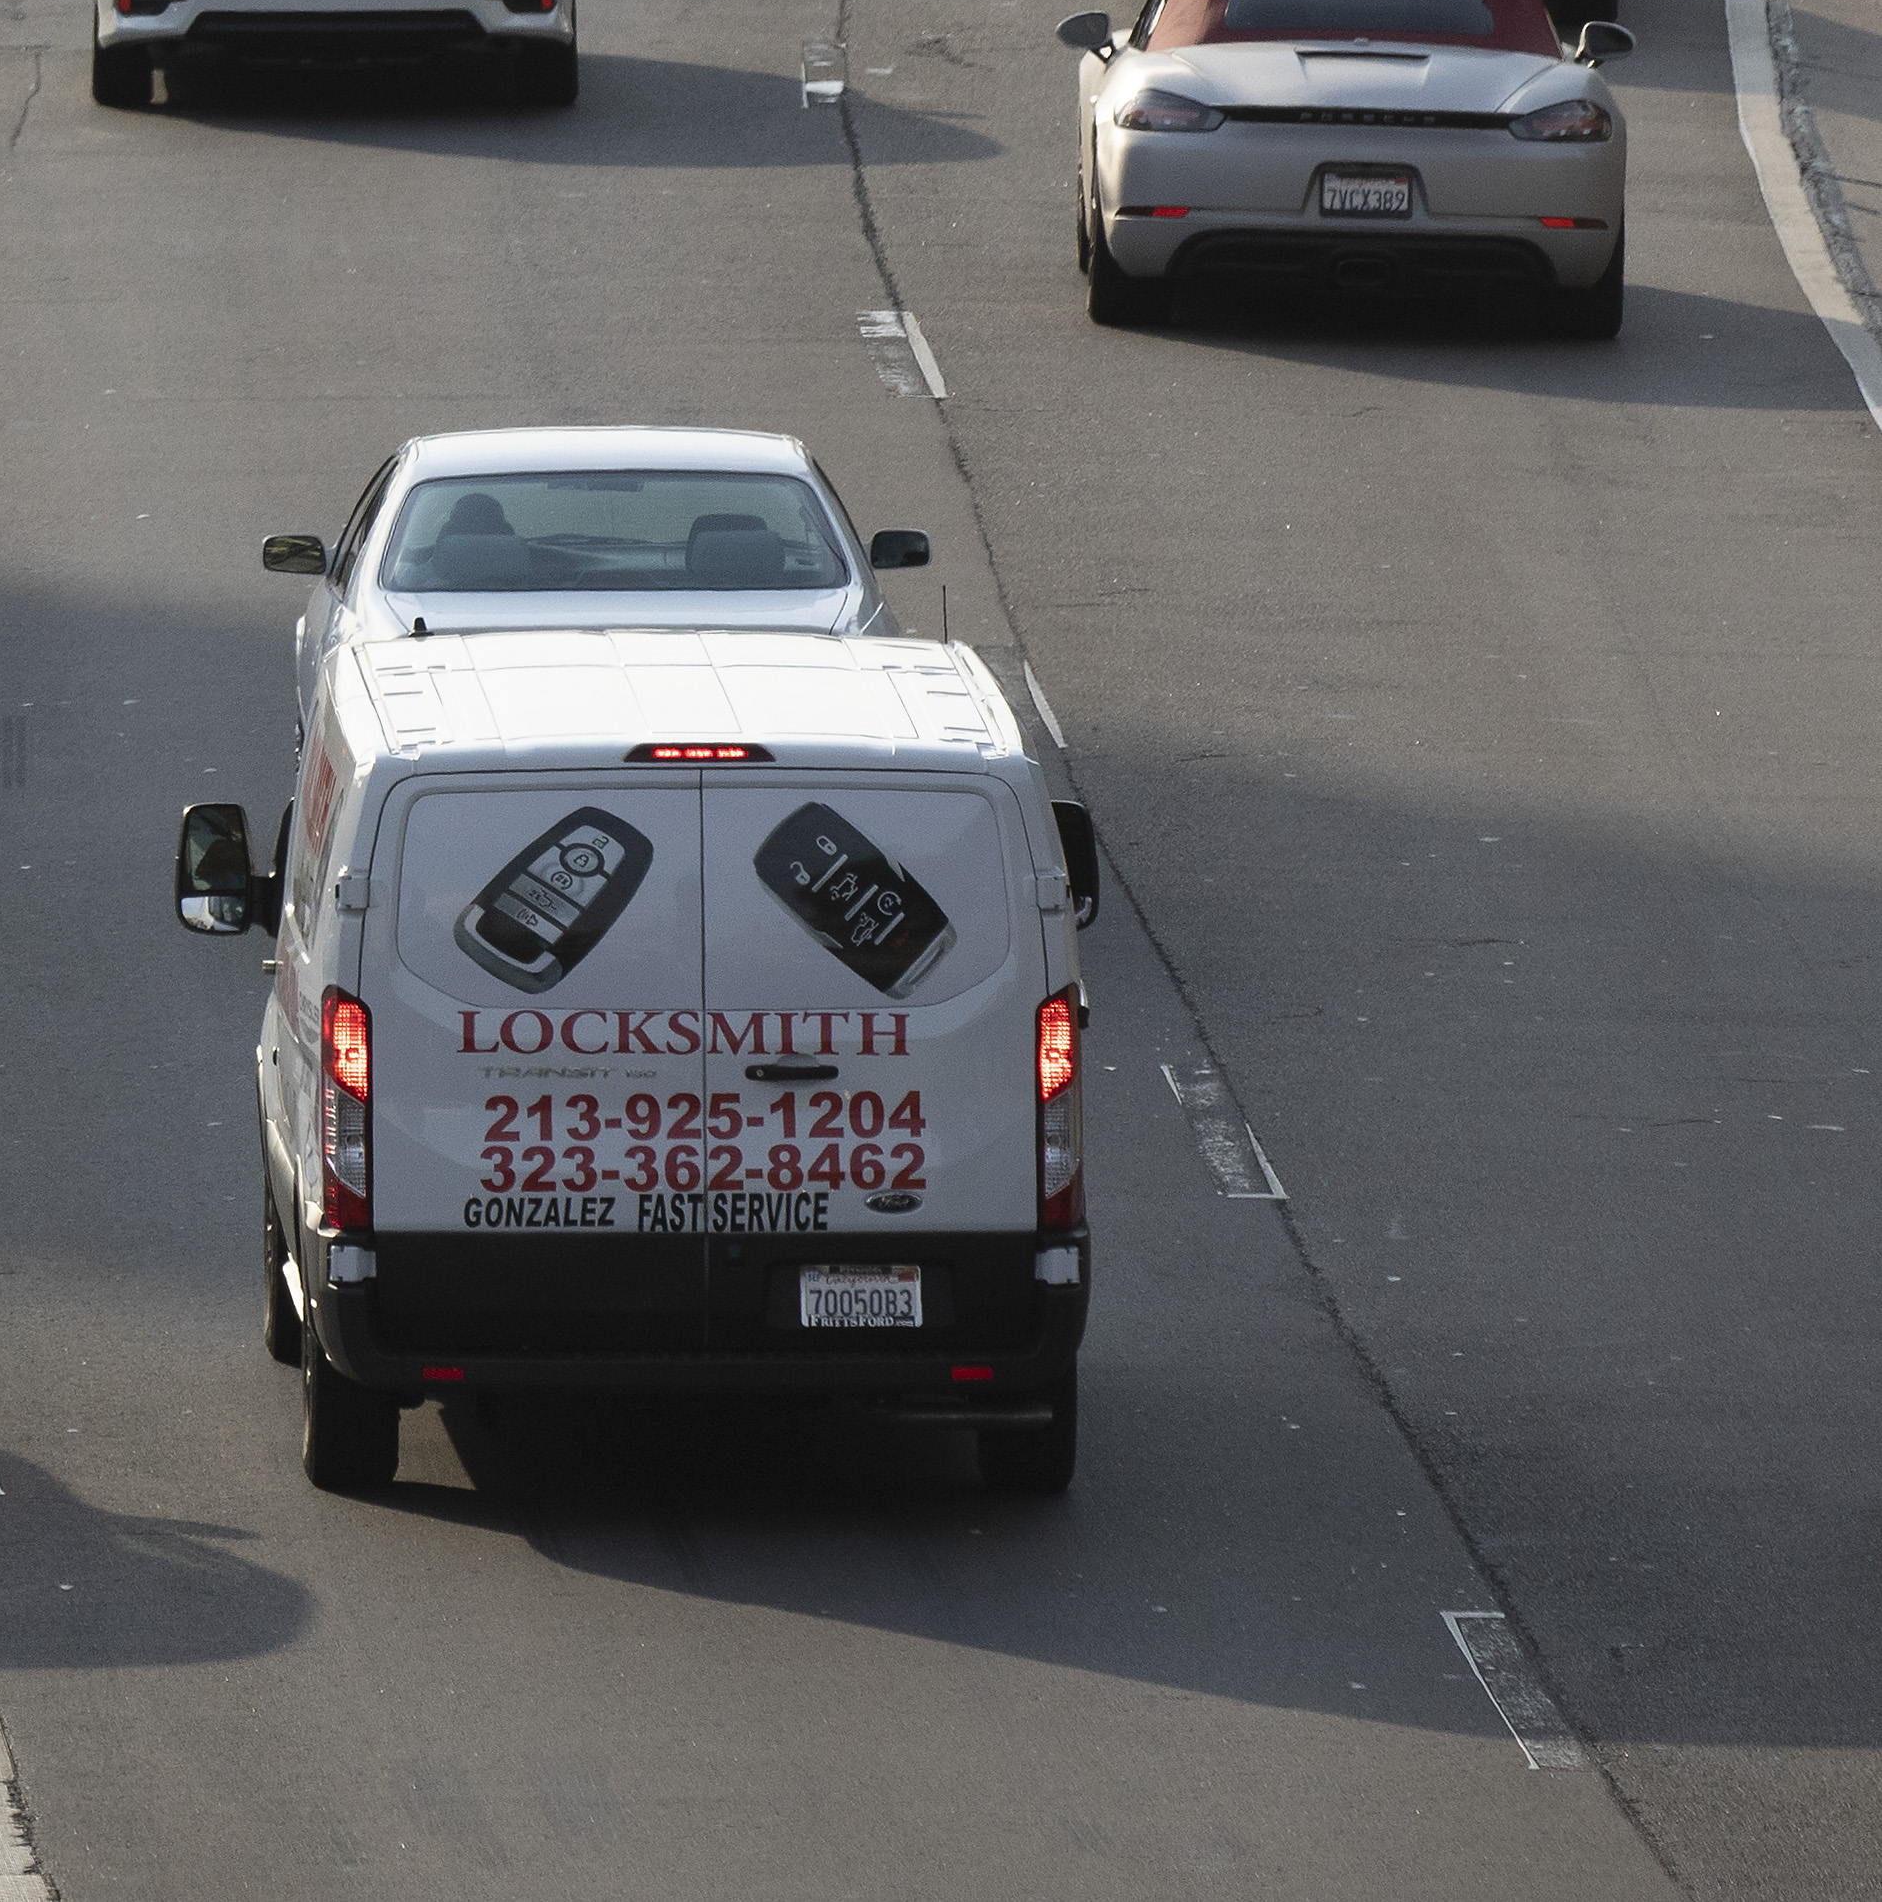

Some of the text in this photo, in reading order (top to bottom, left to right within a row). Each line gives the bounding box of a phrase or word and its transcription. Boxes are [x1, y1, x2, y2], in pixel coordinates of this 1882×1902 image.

[1329, 188, 1405, 211] 7VCX389
[457, 1009, 911, 1057] LOCKSMITH
[484, 1090, 927, 1143] 213-925-1204
[480, 1143, 928, 1194] 323-362-8462
[463, 1191, 830, 1234] GONZALEZ FAST SERVICE
